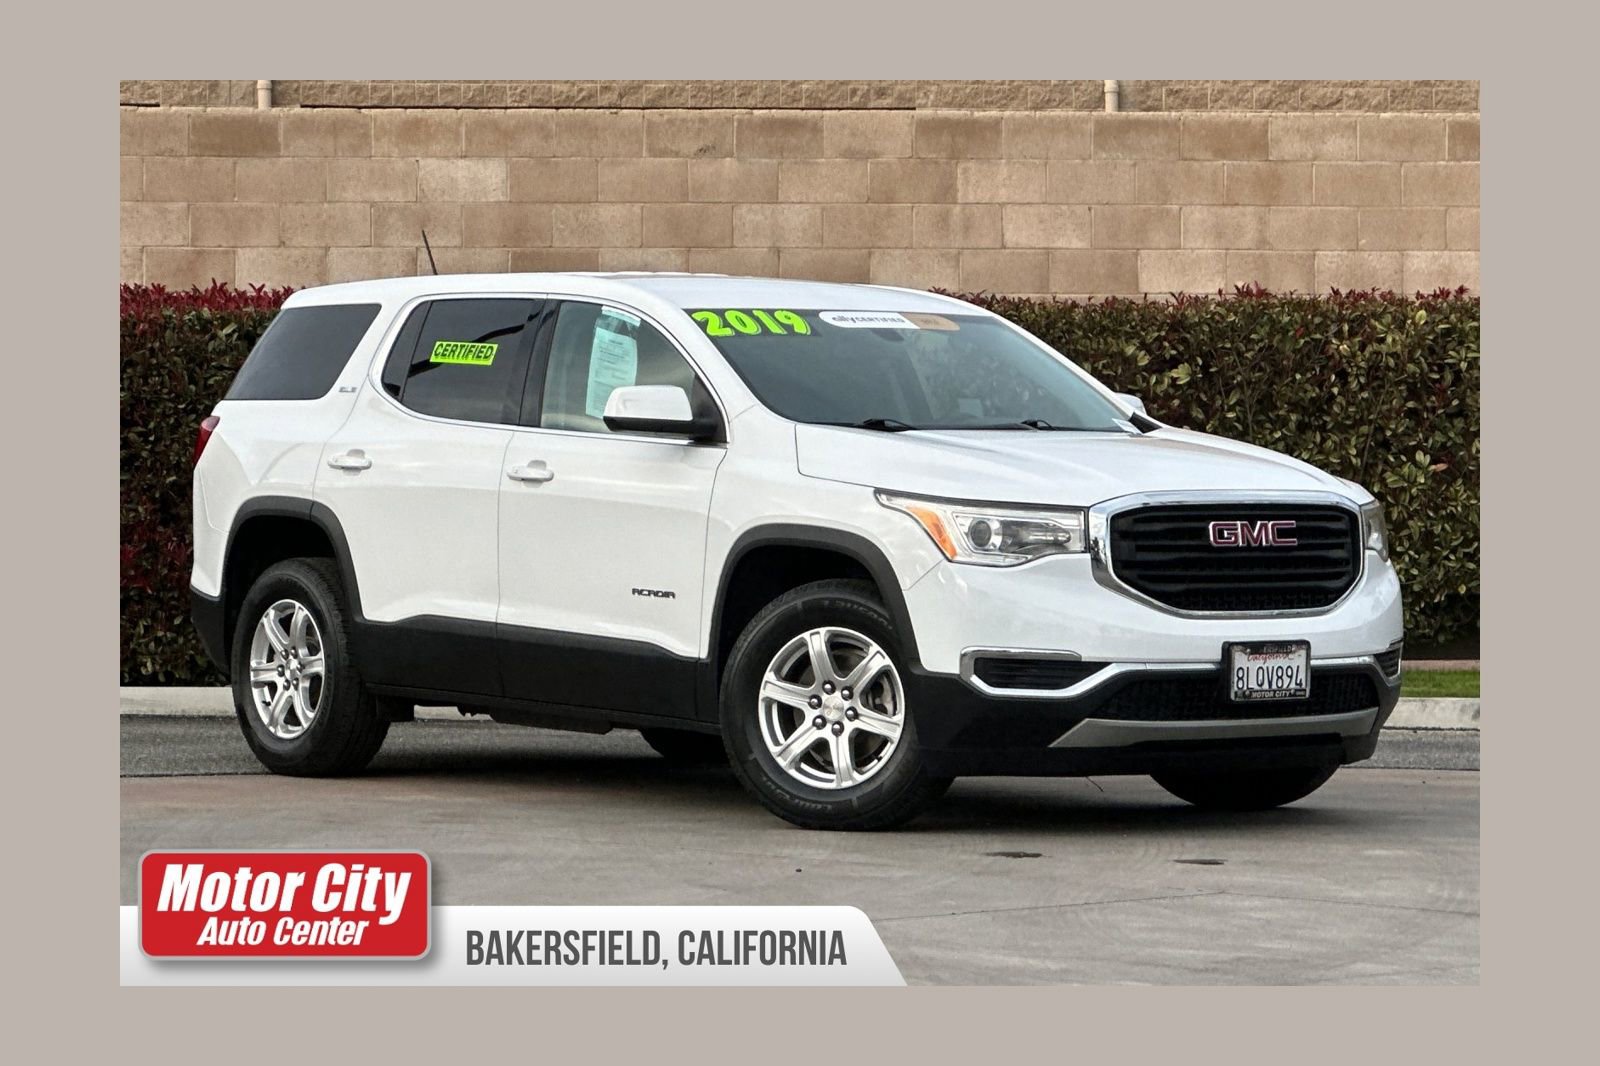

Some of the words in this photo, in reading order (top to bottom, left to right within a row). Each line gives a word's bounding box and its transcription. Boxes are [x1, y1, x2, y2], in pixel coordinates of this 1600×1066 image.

[691, 310, 811, 336] 2019
[434, 343, 494, 359] CERTIFIED
[1209, 521, 1297, 546] GMC
[631, 588, 676, 599] ACADIA
[1236, 665, 1303, 690] 8LQV894
